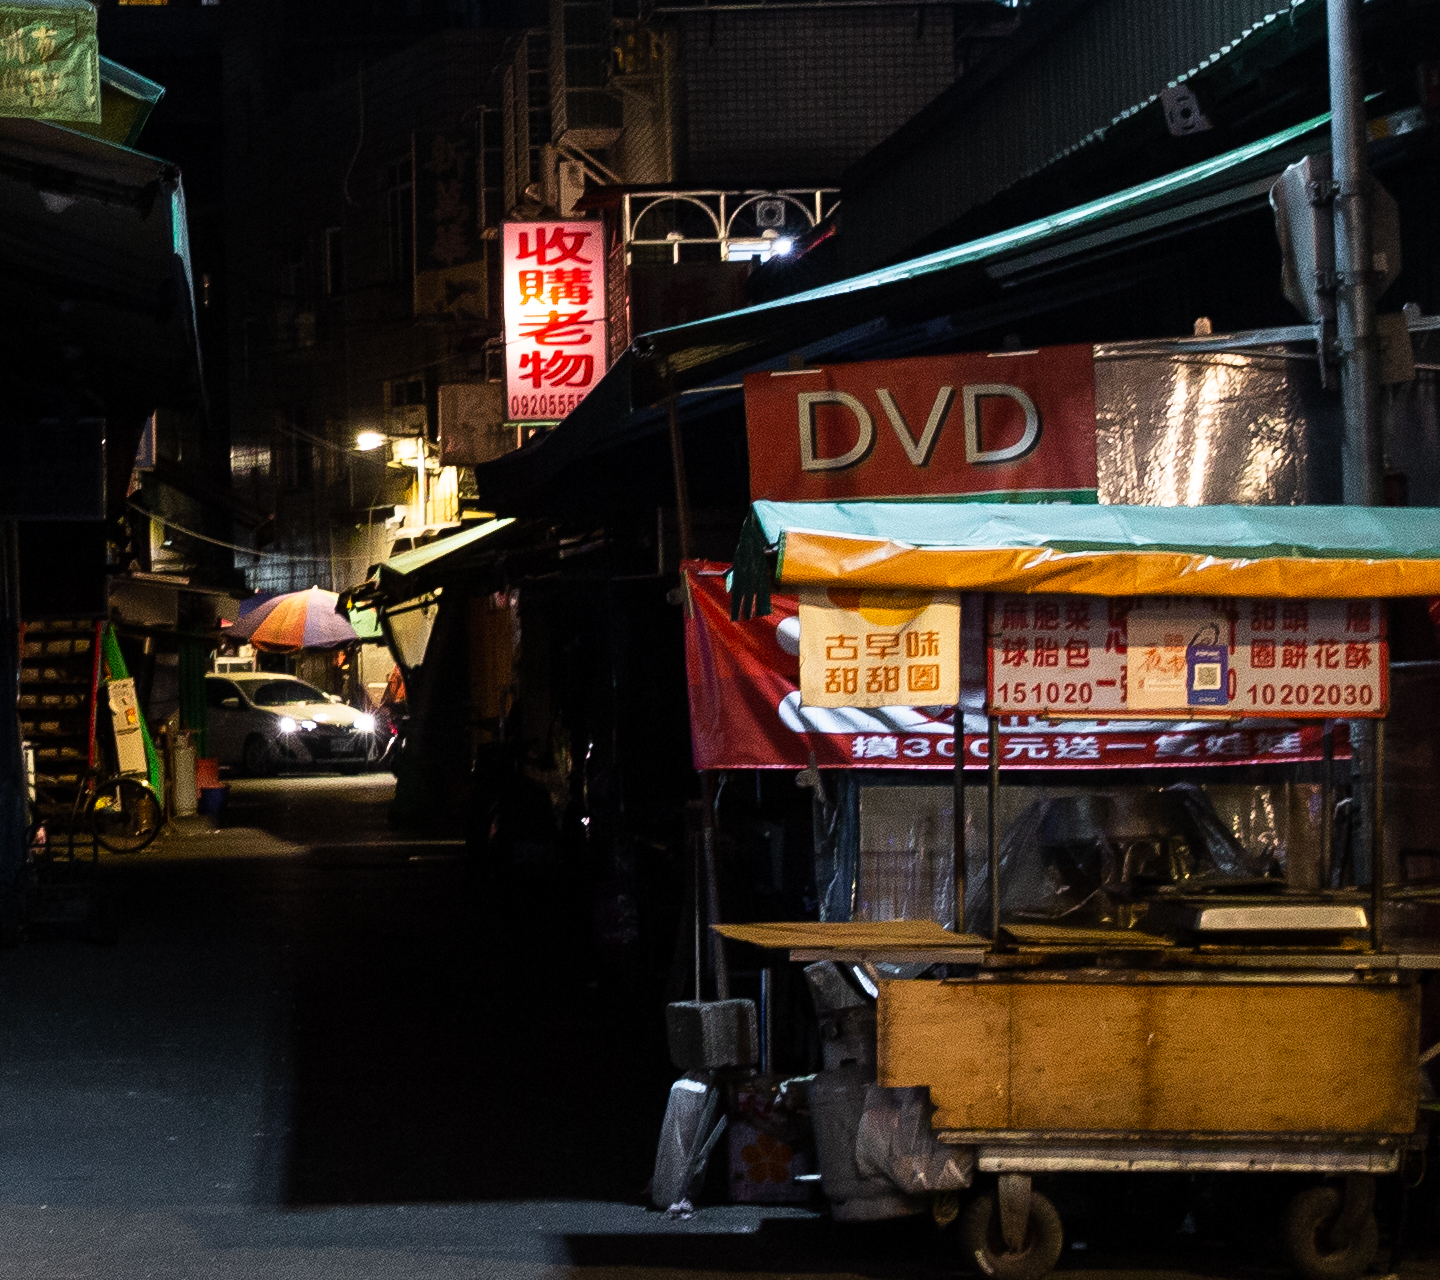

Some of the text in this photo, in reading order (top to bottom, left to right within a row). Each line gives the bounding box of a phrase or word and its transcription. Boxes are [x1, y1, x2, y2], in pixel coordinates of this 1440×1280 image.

[516, 227, 594, 389] 收購老物
[798, 383, 1042, 472] DVD
[824, 630, 940, 661] 古早味
[824, 663, 940, 695] 甜甜圈
